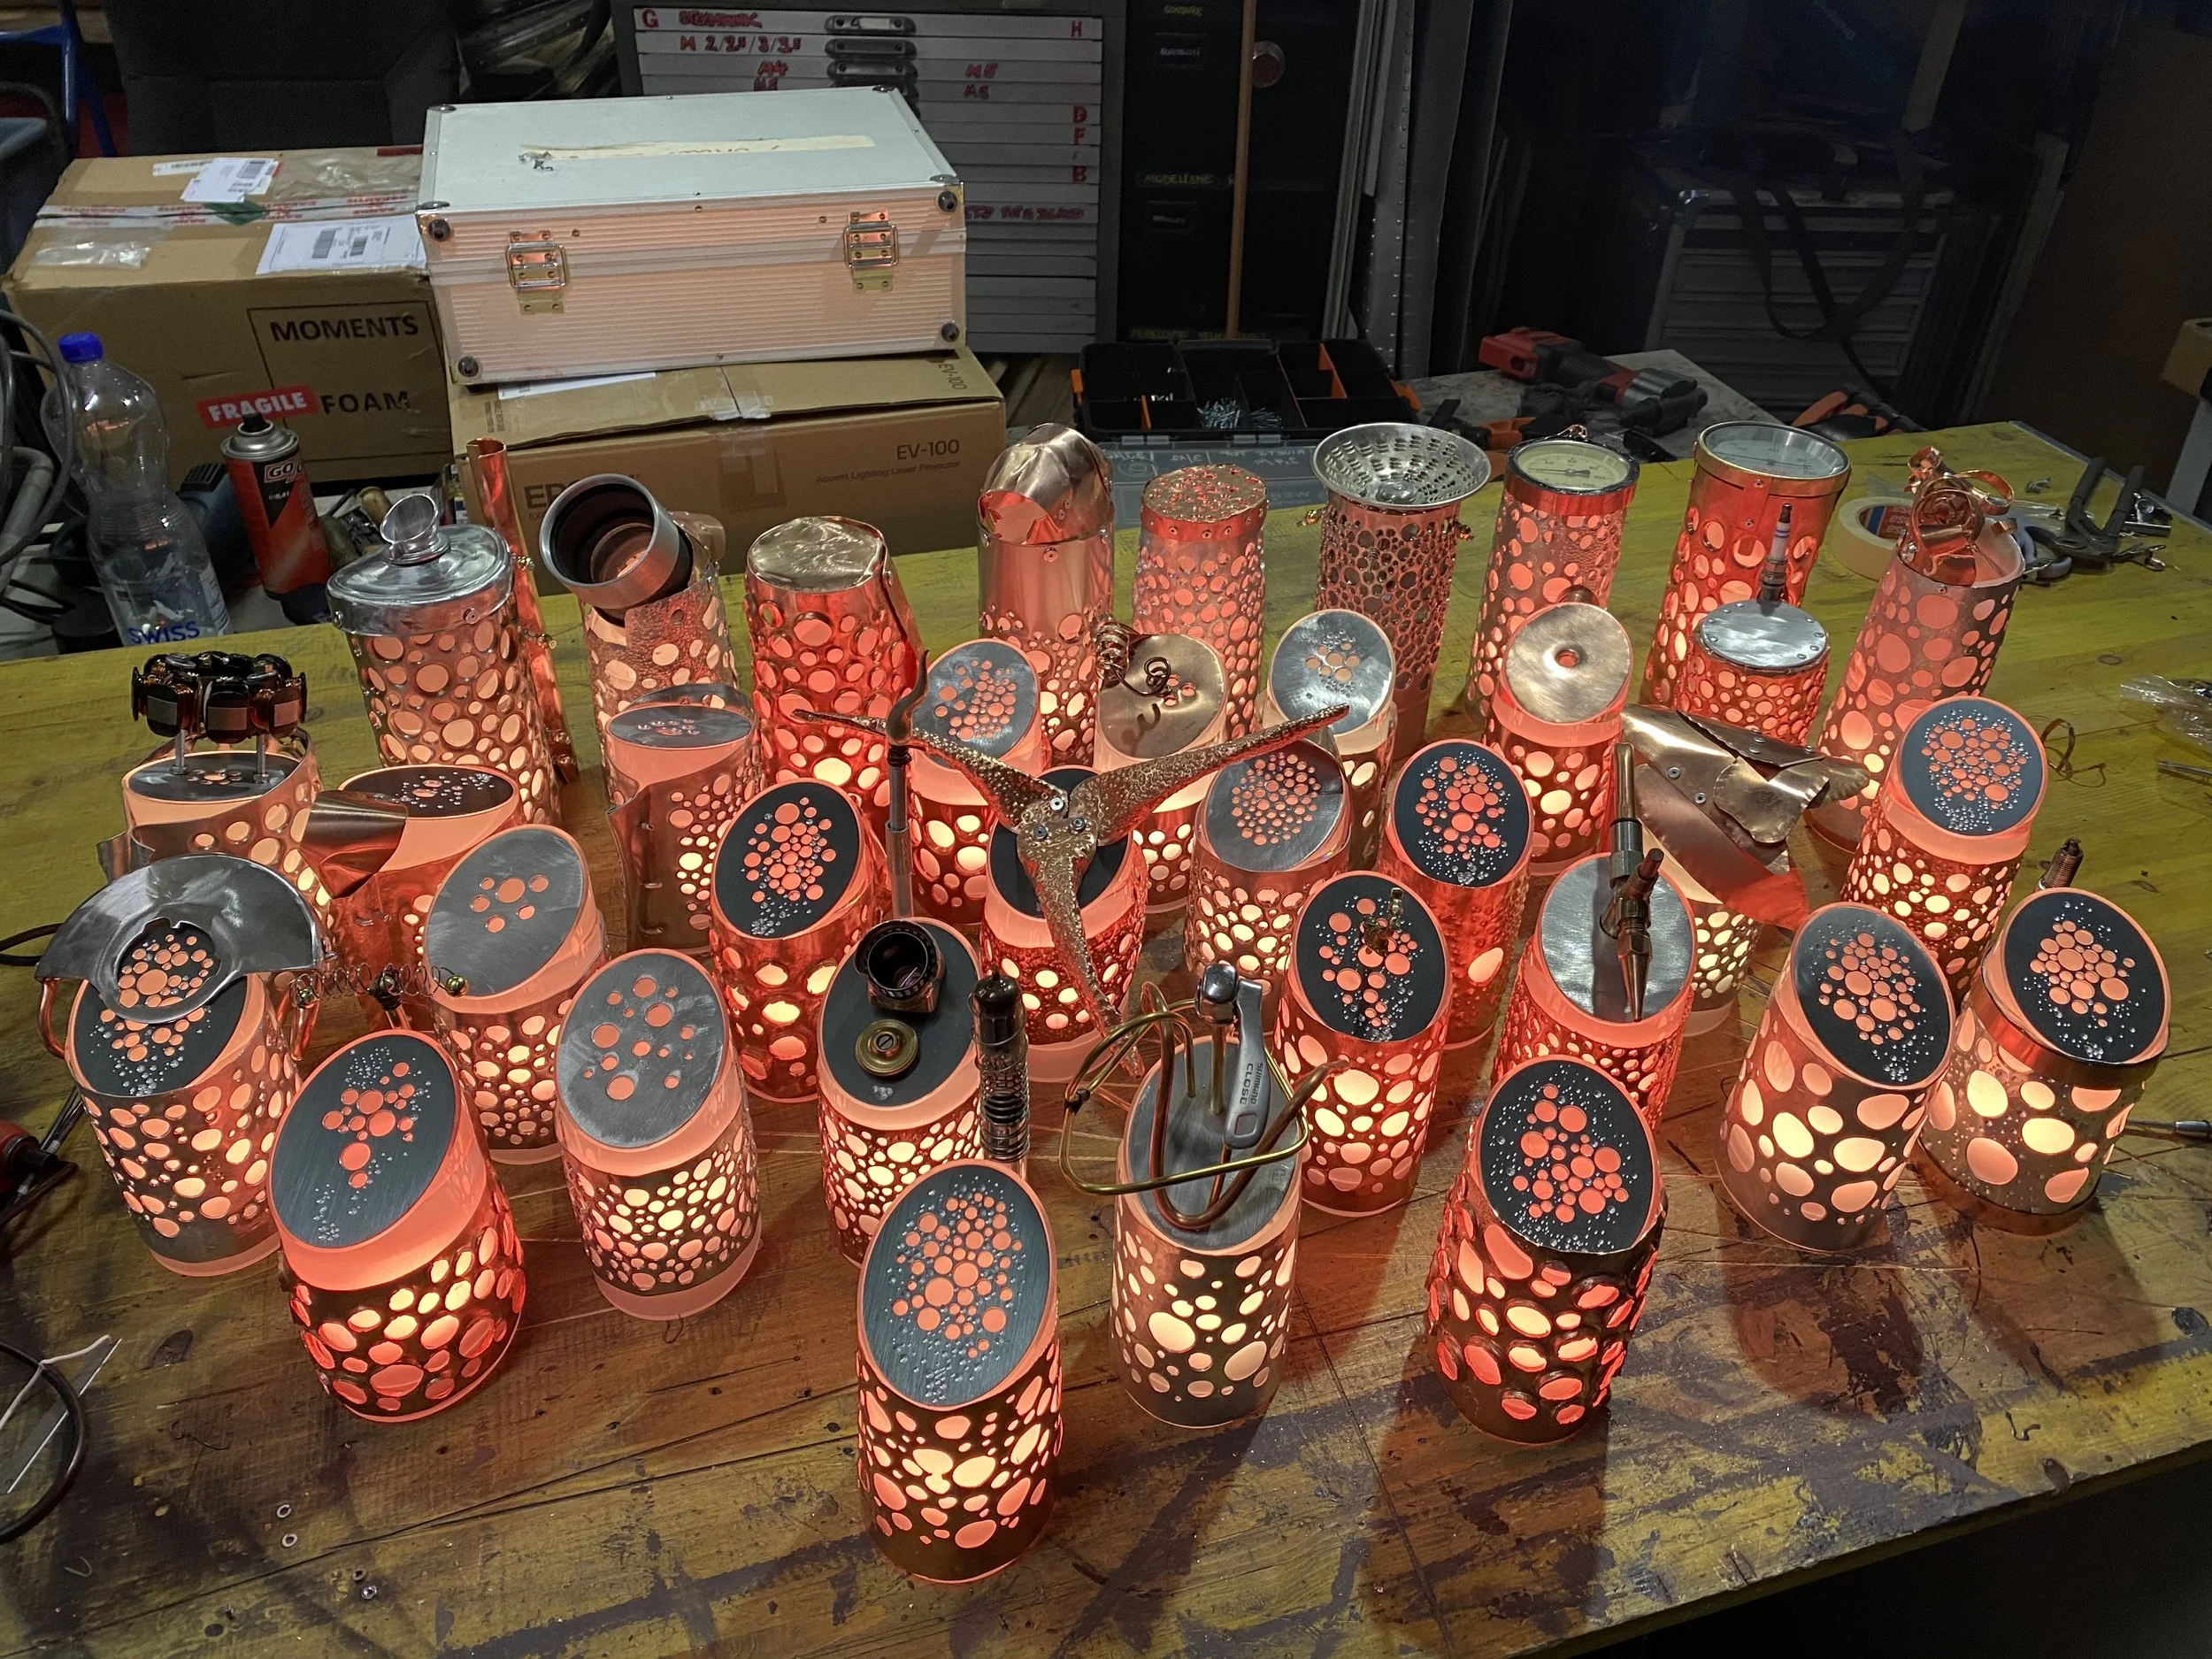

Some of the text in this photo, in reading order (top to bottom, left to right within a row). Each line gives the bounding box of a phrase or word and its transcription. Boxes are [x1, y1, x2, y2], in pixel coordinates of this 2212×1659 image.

[641, 8, 659, 28] G
[1071, 19, 1083, 37] H
[1072, 105, 1087, 123] D
[1073, 127, 1086, 146] F
[1072, 165, 1087, 184] B
[270, 314, 419, 342] MOMENTS
[938, 362, 968, 390] EV-100
[207, 391, 308, 422] FRAGILE
[320, 390, 411, 415] FOAM
[896, 438, 960, 461] EV-100
[816, 460, 960, 484] Accent Lighting Laser Projector
[127, 620, 200, 645] SWISS
[1240, 1063, 1254, 1105] CLOSE
[1250, 1062, 1263, 1105] SHIMANO
